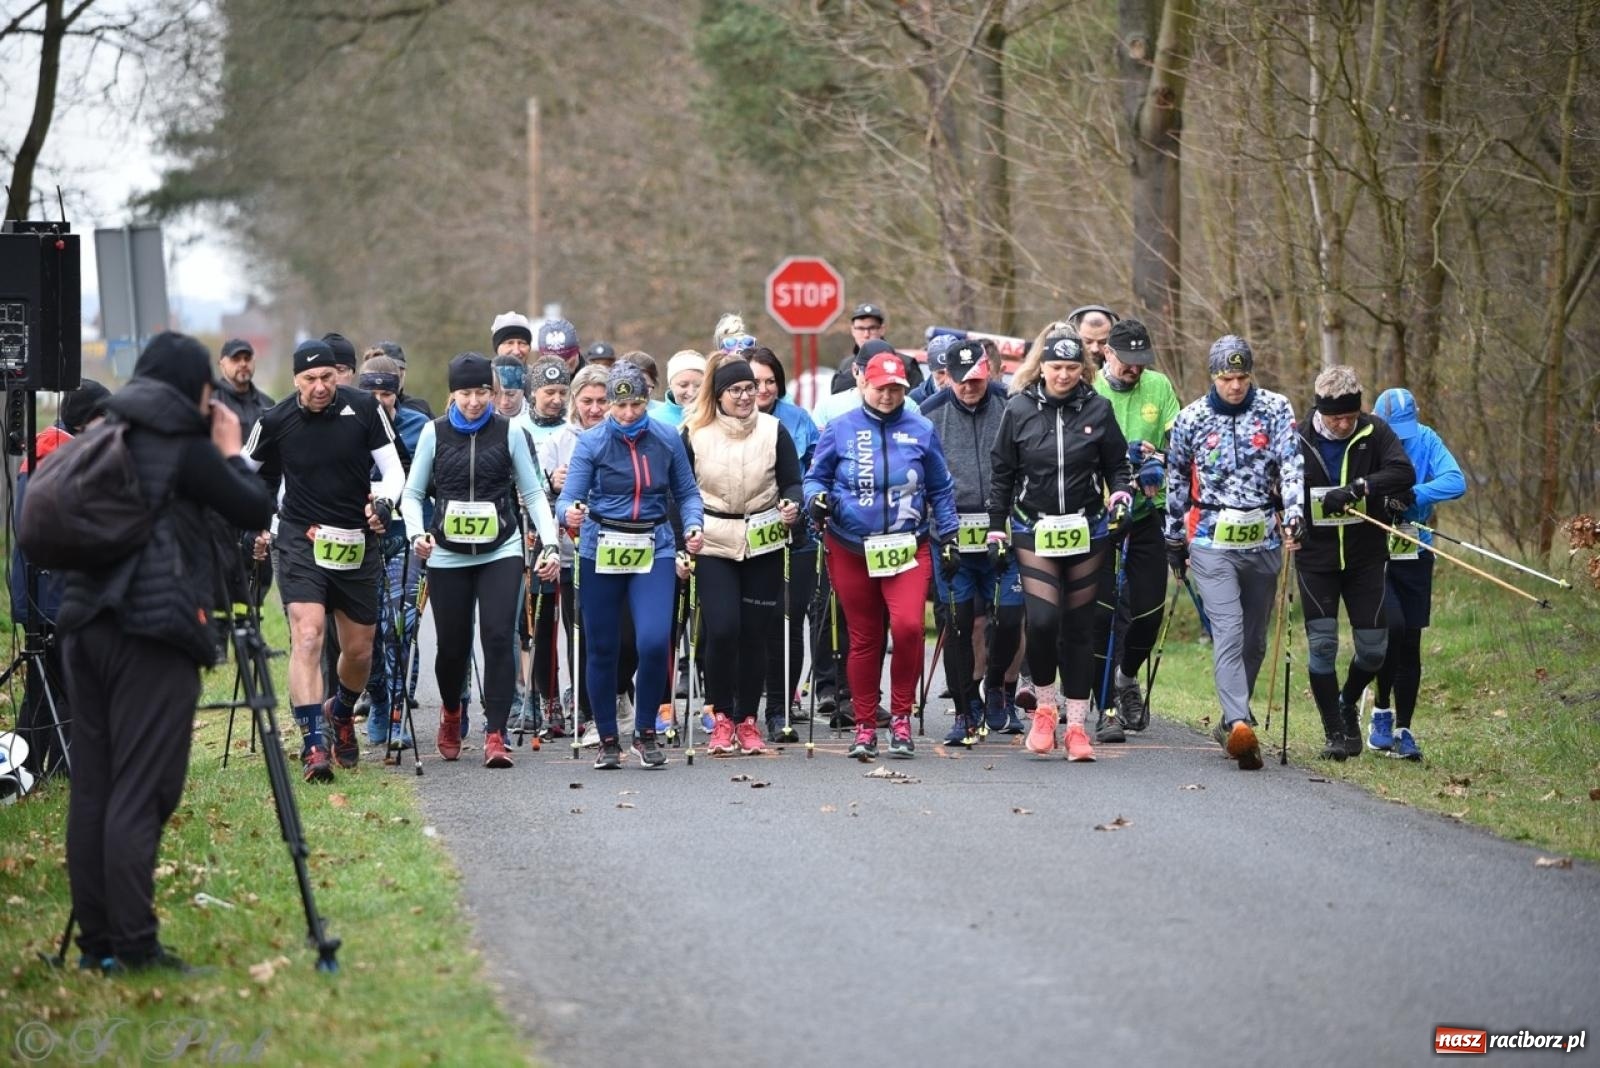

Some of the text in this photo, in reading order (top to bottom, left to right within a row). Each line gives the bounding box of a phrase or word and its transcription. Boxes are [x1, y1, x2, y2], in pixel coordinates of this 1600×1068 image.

[775, 282, 836, 307] STOP
[856, 429, 875, 507] RUNNERS
[453, 517, 490, 535] 157
[756, 521, 787, 546] 168
[967, 527, 990, 545] 17
[1224, 523, 1260, 542] 158
[1044, 529, 1082, 549] 159
[1391, 536, 1411, 552] 79
[322, 542, 358, 562] 175
[606, 547, 646, 566] 167
[875, 547, 909, 569] 181
